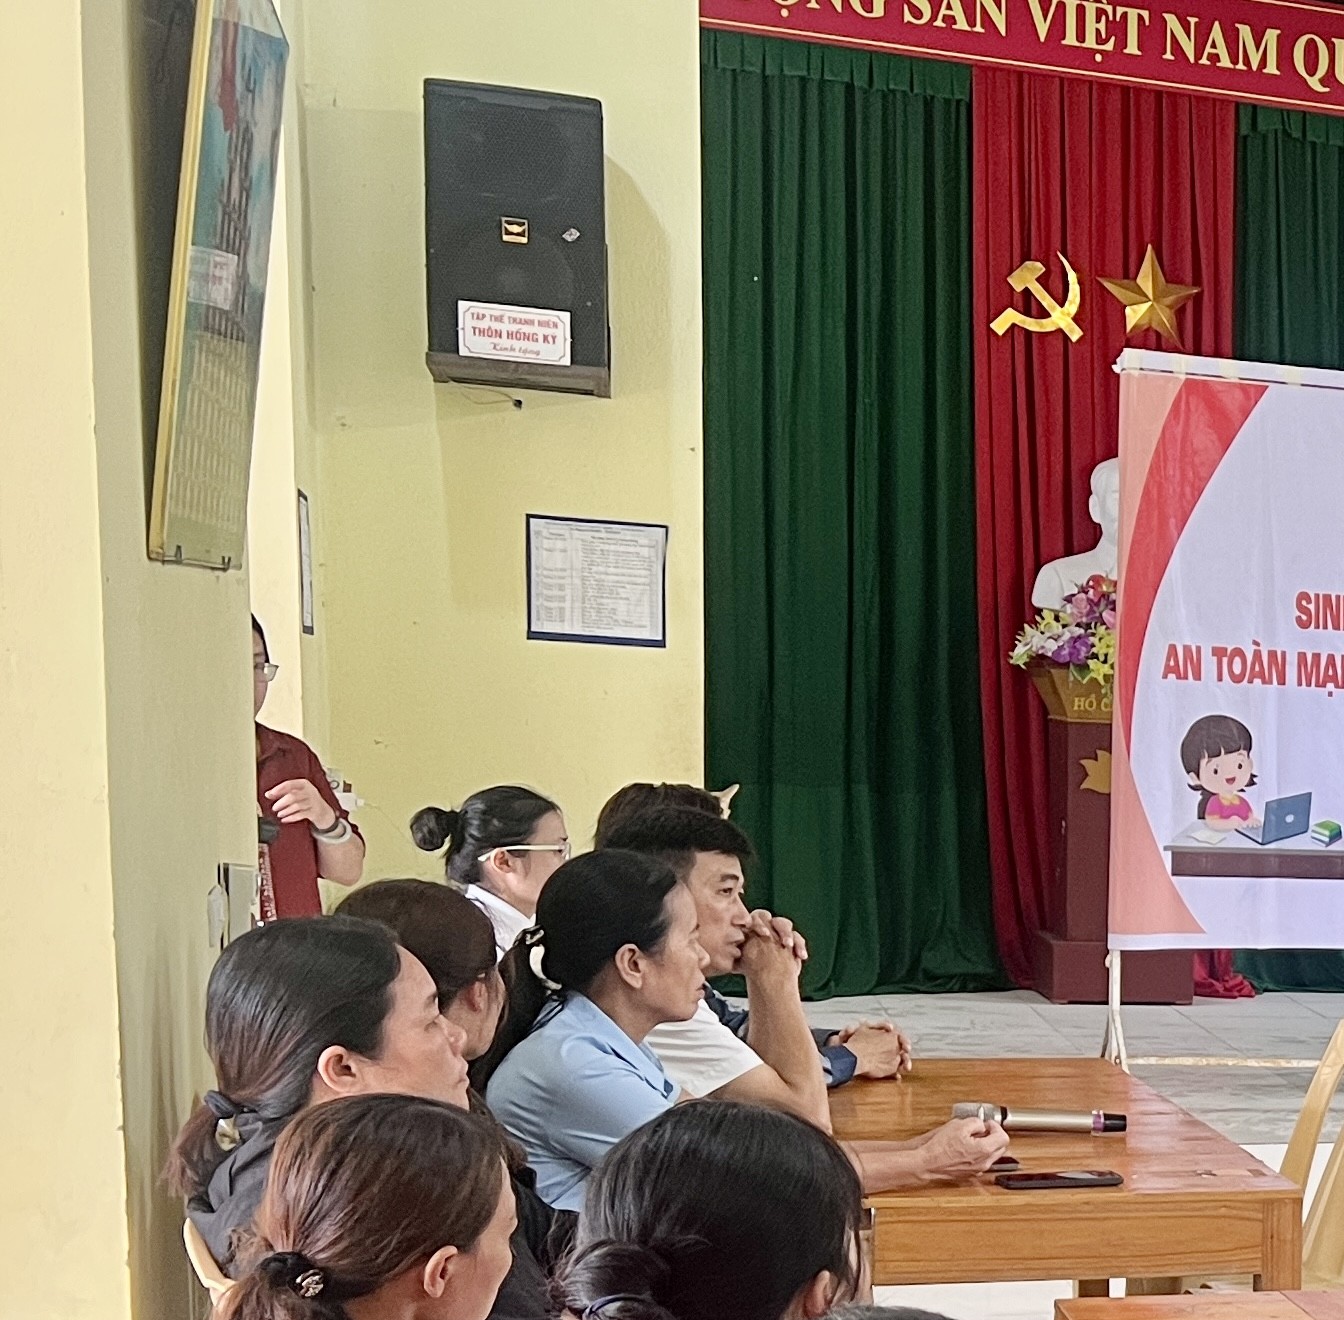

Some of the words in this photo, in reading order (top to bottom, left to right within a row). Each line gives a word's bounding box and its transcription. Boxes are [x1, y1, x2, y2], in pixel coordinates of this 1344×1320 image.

[1028, 0, 1150, 62] VIỆT
[1161, 12, 1282, 76] NAM
[1161, 643, 1202, 682] AN
[1211, 639, 1287, 686] TOÀN
